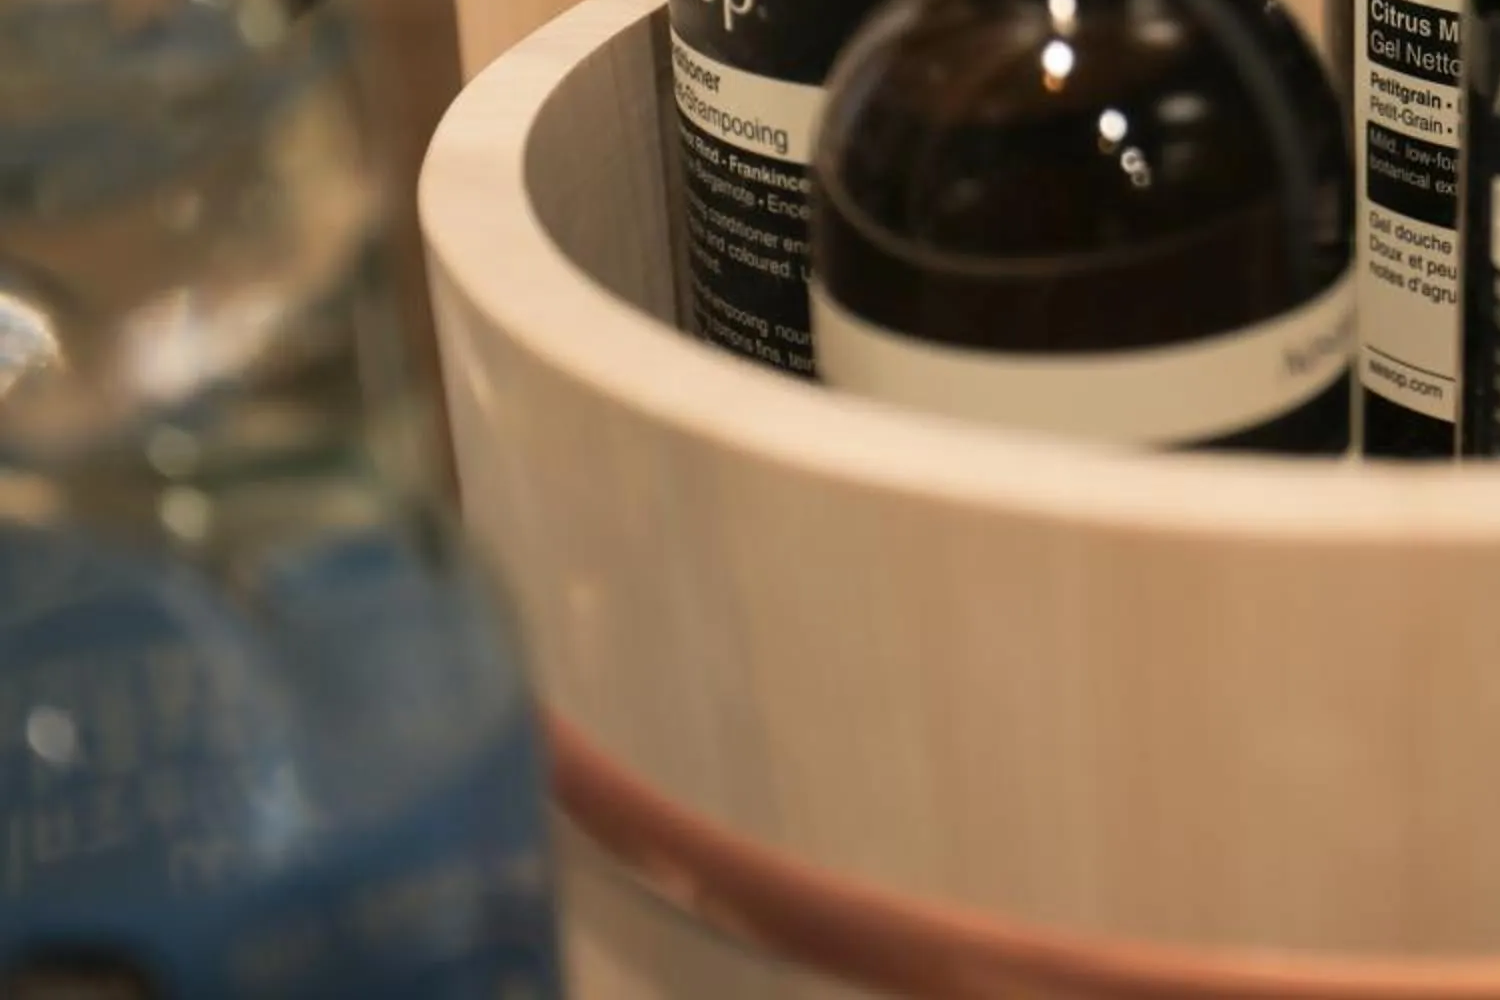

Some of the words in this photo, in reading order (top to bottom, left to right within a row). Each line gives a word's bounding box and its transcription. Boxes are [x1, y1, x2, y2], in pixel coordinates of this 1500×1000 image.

[1439, 17, 1460, 43] M
[1371, 29, 1400, 60] Gel
[1406, 41, 1465, 78] Netto
[1370, 70, 1442, 110] Petitgrain
[1370, 95, 1444, 135] Petit-Grain
[1395, 225, 1453, 255] douche
[1408, 254, 1423, 271] et
[1427, 261, 1457, 281] peu
